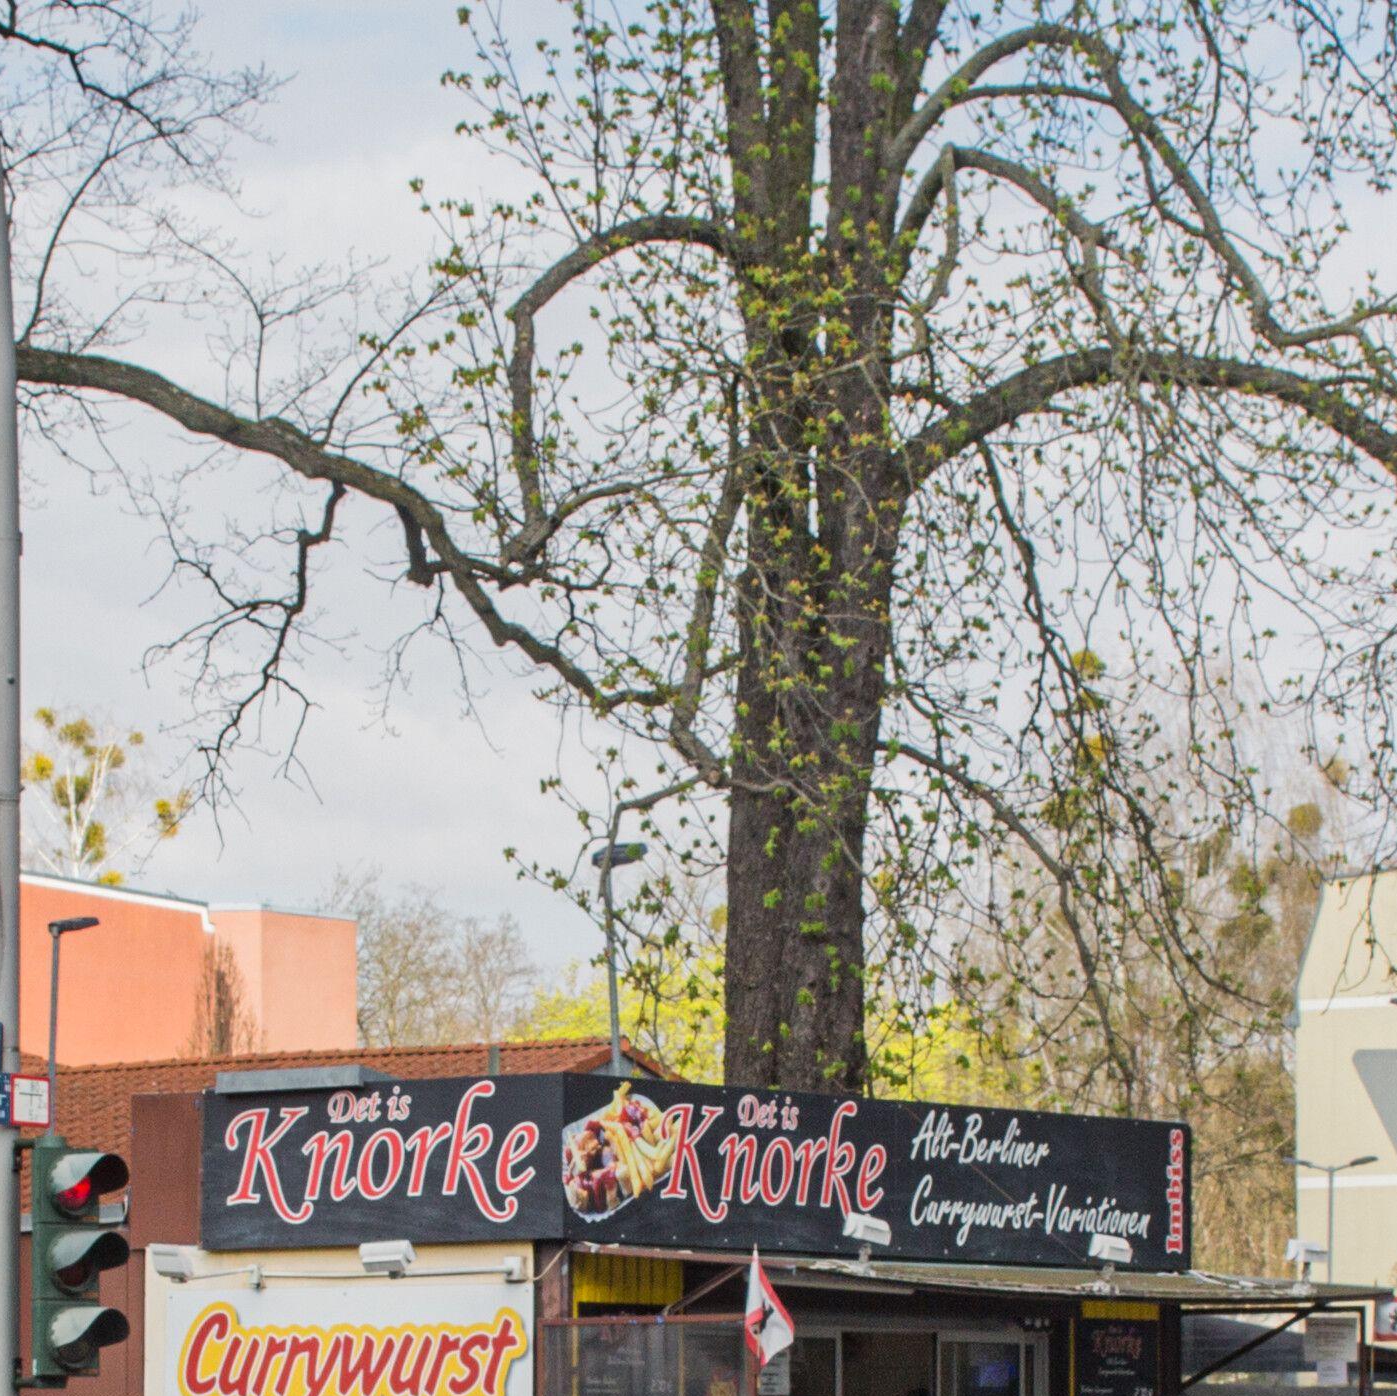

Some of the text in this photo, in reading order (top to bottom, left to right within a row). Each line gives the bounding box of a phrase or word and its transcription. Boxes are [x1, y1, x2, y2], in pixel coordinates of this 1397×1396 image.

[327, 1086, 412, 1123] Det is
[737, 1094, 800, 1130] Det is
[910, 1109, 1050, 1168] Alt-Berliner
[225, 1080, 540, 1224] Knorke
[660, 1100, 887, 1223] Knorke
[909, 1174, 1152, 1246] Currywurst-Variationen
[1166, 1128, 1184, 1254] Imbiss
